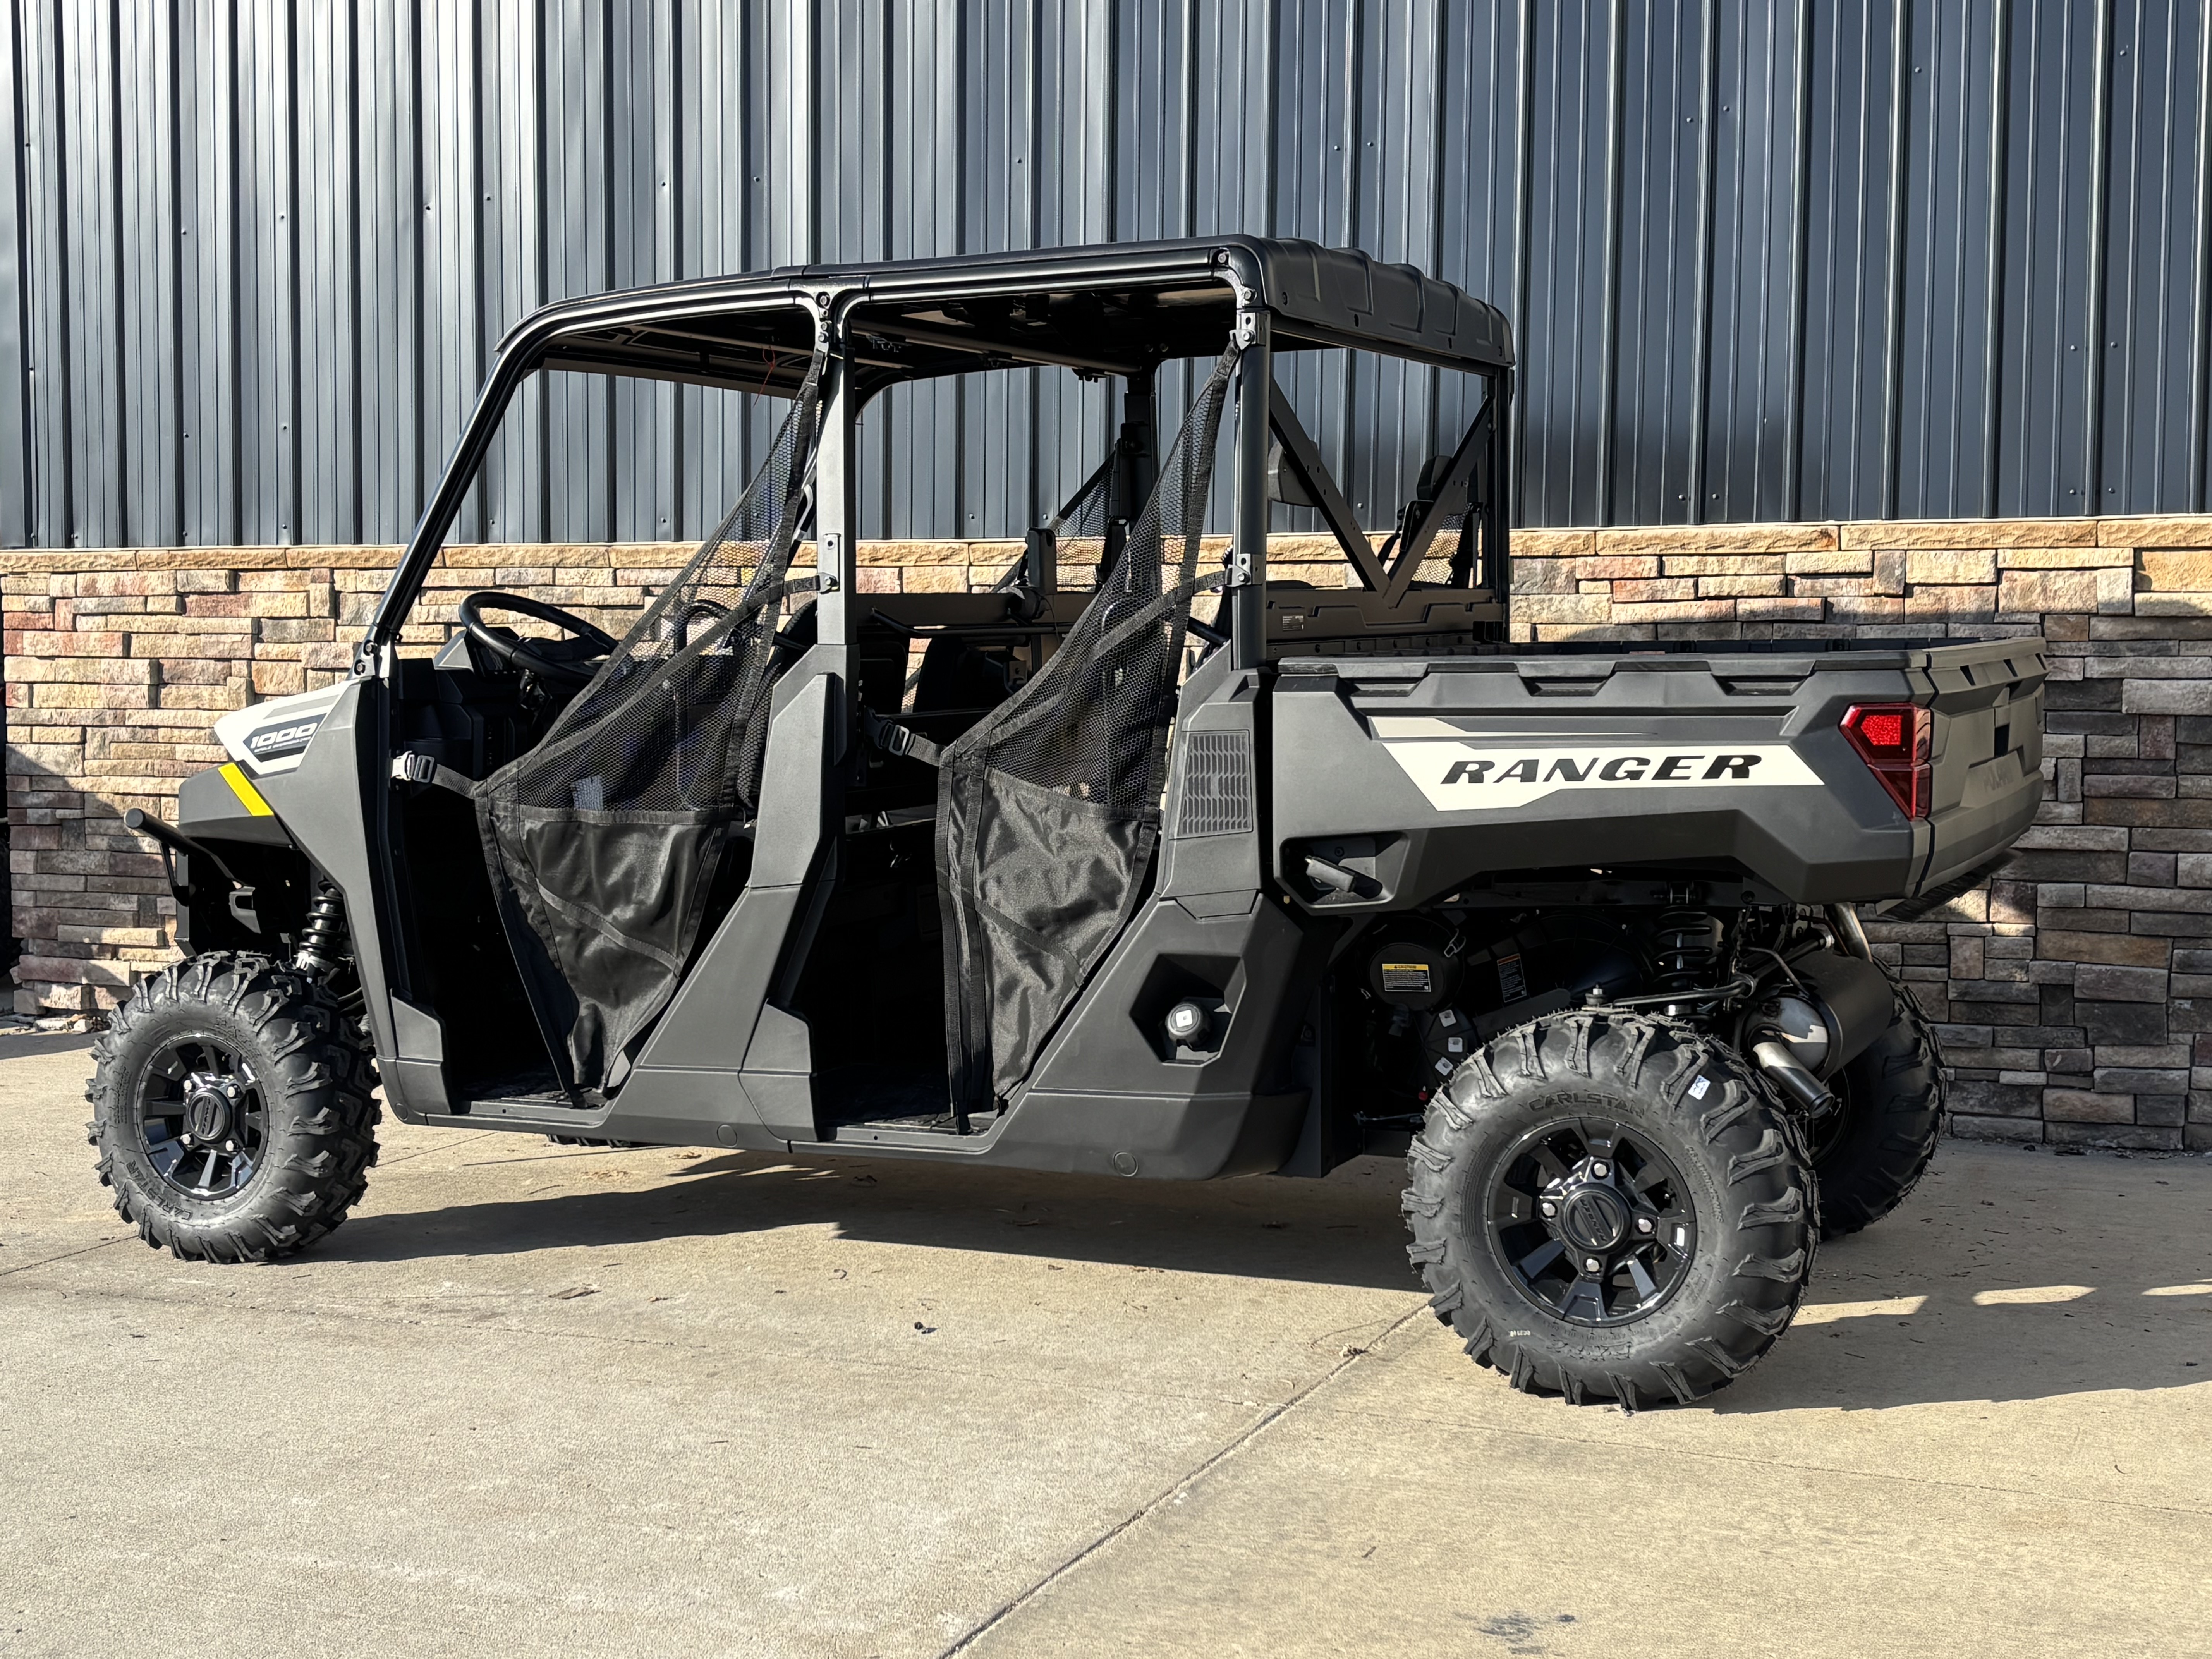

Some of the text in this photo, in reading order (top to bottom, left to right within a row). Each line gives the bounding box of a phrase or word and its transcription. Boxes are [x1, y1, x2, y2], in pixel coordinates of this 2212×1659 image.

[250, 723, 318, 749] 1000
[1441, 755, 1761, 784] RANGER
[1529, 1092, 1645, 1119] CARLSTAR
[126, 1159, 193, 1221] CARLSTAR
